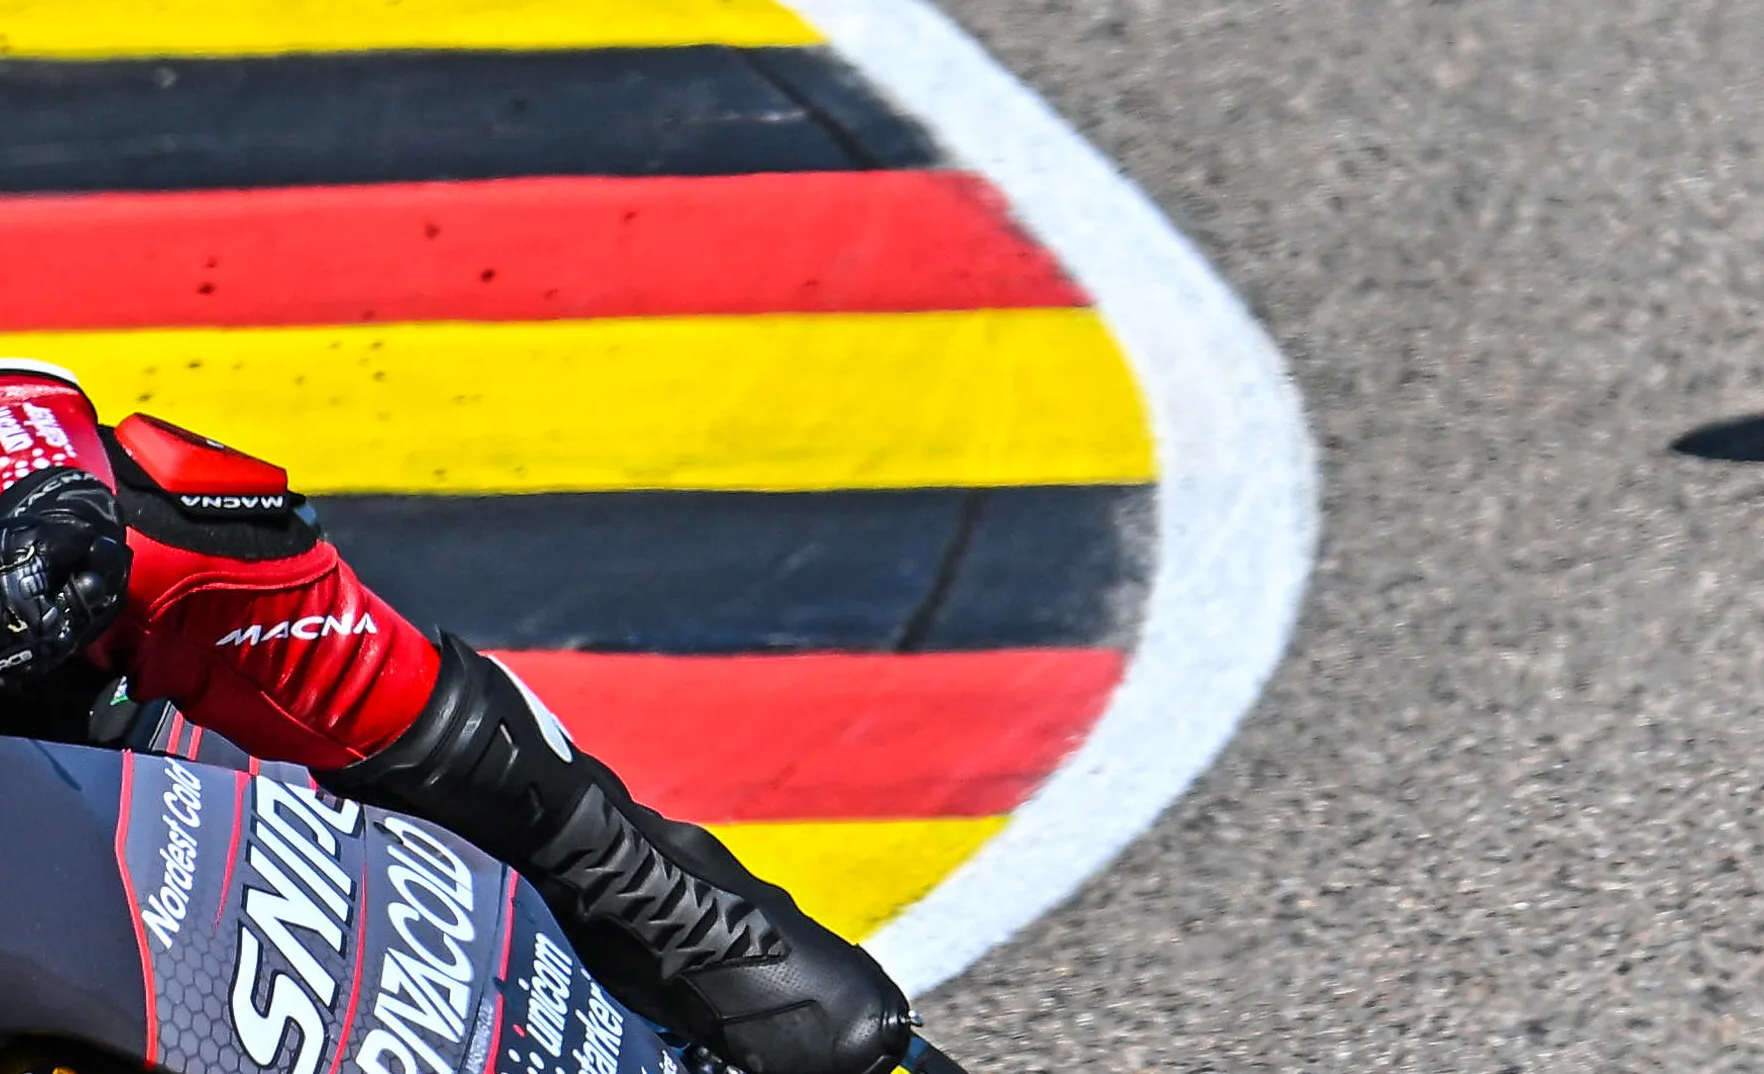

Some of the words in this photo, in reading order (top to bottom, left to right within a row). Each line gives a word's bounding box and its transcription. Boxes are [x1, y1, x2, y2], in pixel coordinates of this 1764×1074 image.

[180, 495, 284, 510] MACNA
[214, 611, 378, 647] MACNA
[162, 756, 203, 829] Cold
[141, 814, 199, 950] Nordest
